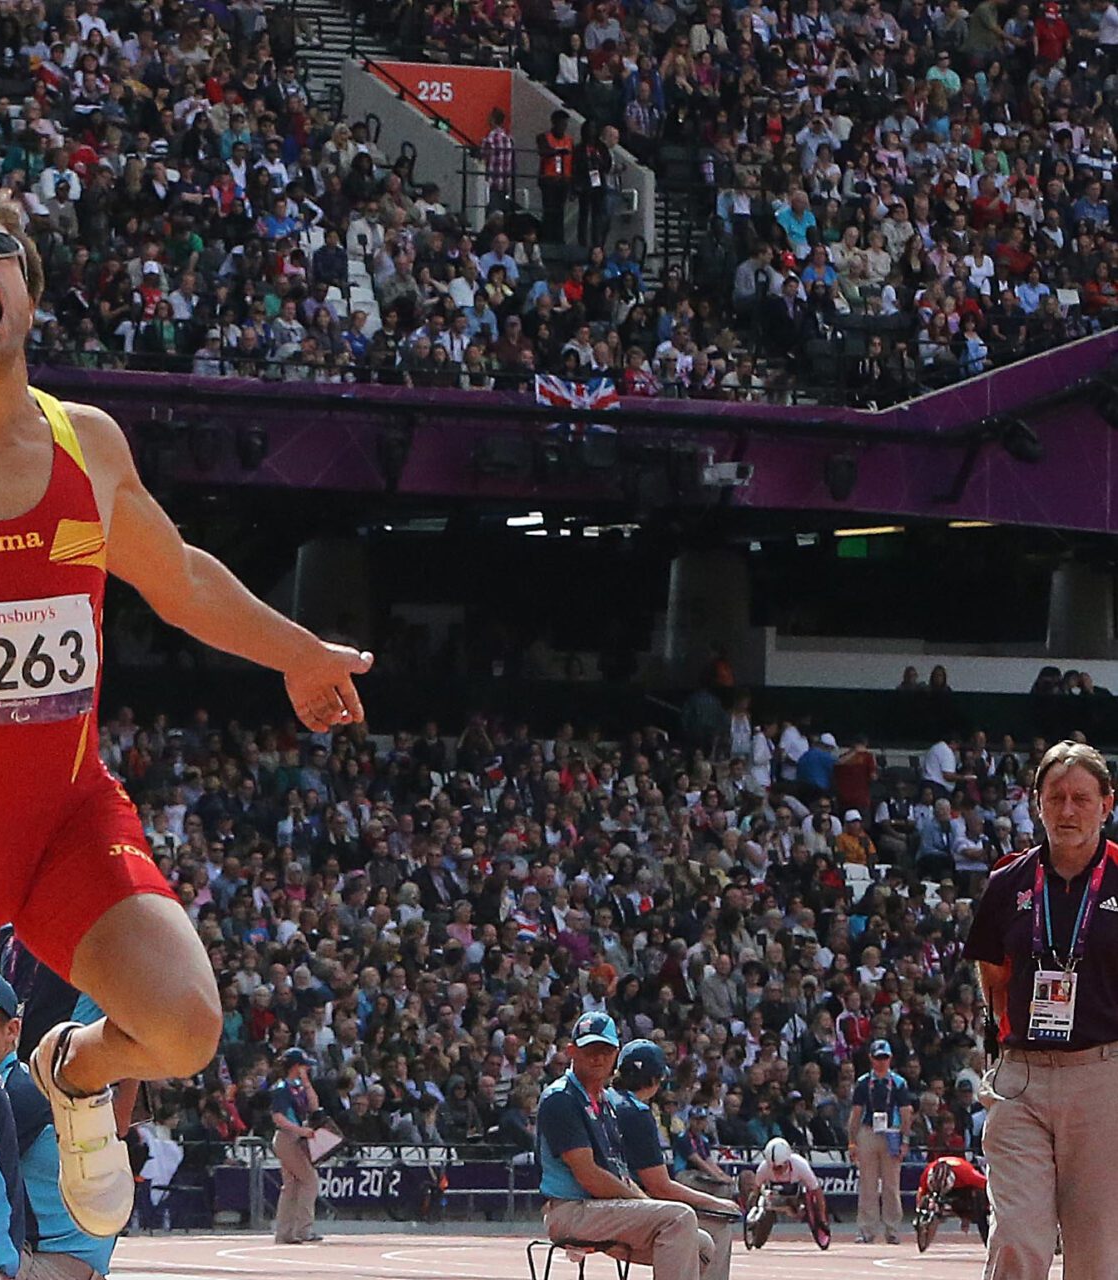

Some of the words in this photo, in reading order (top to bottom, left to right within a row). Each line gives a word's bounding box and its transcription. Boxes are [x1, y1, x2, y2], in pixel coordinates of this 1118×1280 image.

[417, 81, 453, 102] 225
[318, 1169, 354, 1198] don
[358, 1168, 401, 1198] 202
